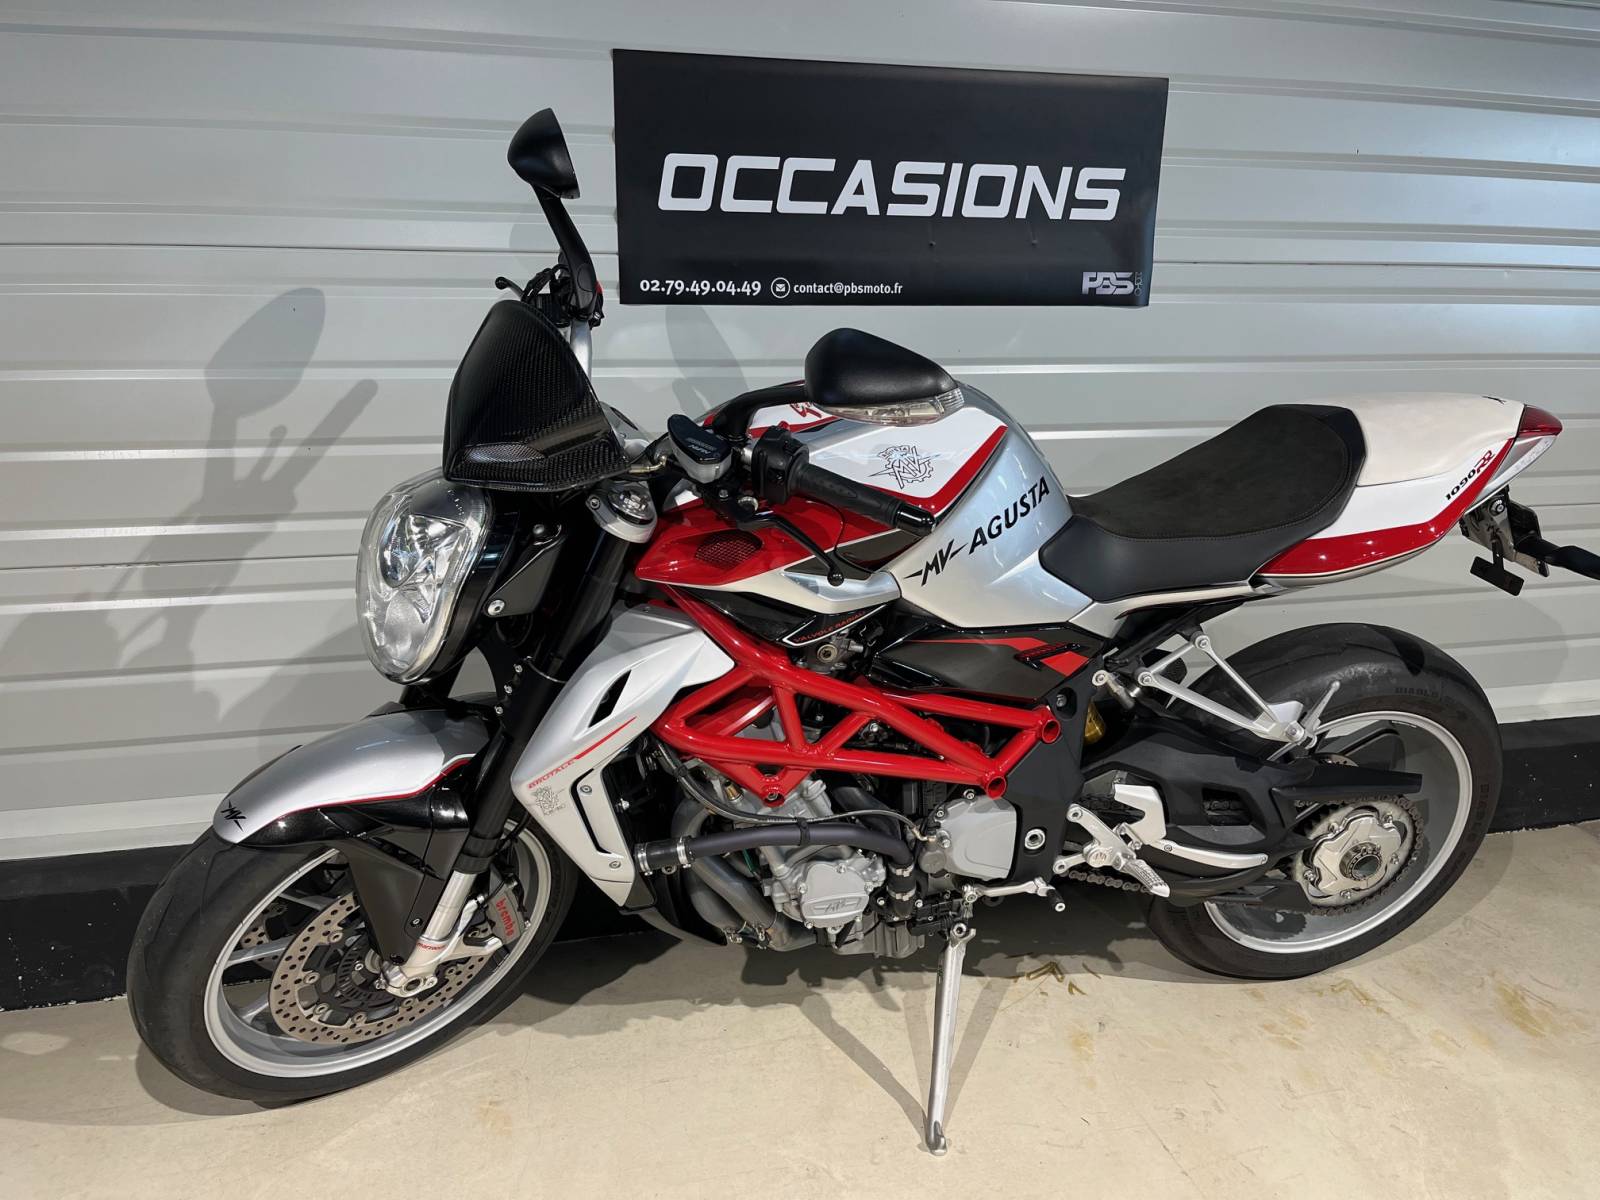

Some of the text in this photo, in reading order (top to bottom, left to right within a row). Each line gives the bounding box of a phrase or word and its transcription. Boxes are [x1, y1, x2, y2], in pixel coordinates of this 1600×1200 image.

[658, 153, 1127, 221] OCCASIONS
[639, 279, 903, 296] 02.79.49.04.49 contact@pbsmoto.fr
[1081, 271, 1134, 295] PBS
[968, 476, 1050, 555] AGUSTA
[496, 897, 516, 937] brembo
